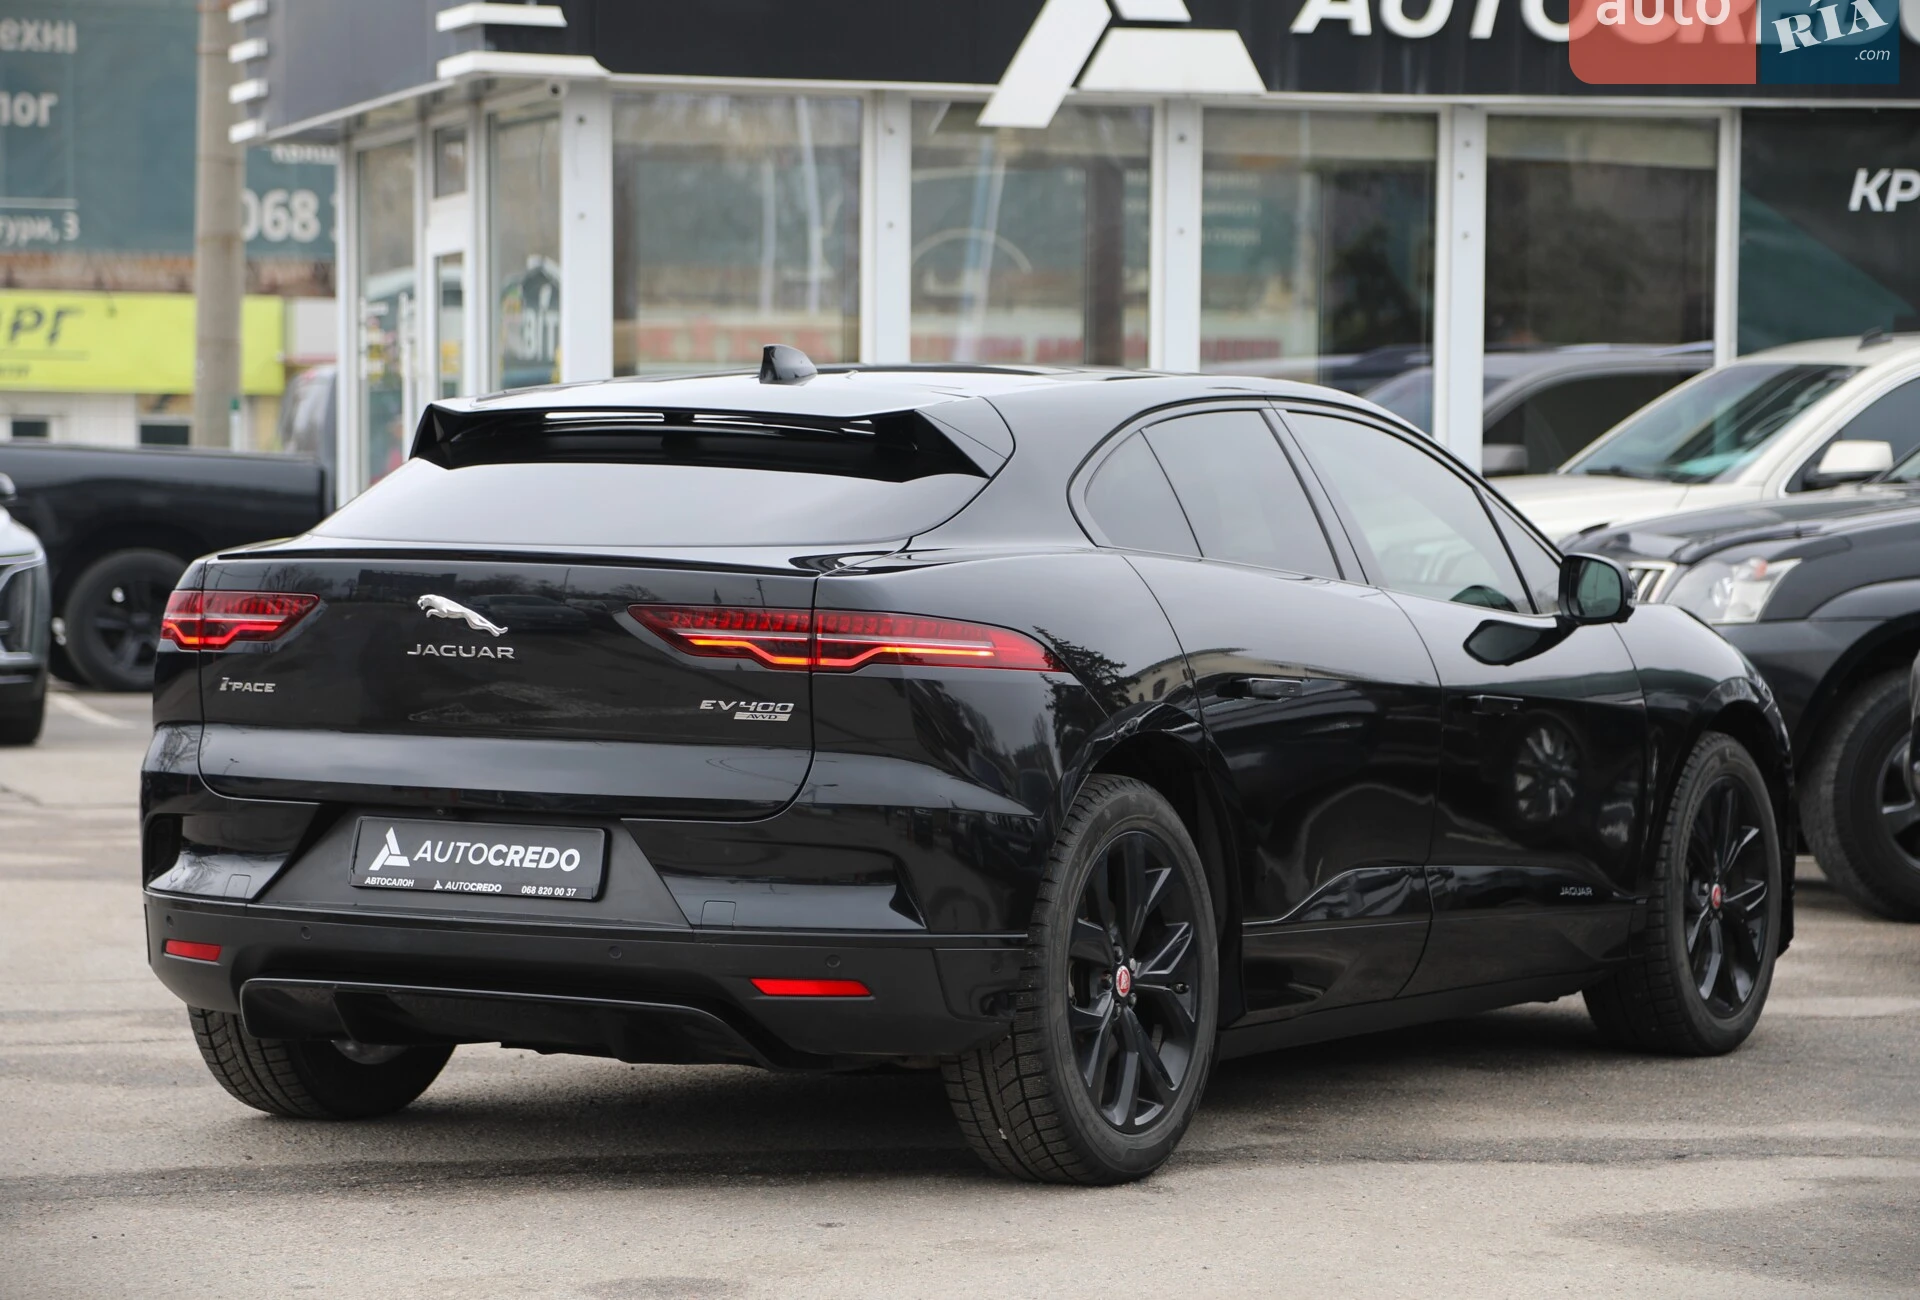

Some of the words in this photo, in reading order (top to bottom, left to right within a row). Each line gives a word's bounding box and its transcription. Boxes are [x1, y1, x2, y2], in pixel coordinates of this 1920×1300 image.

[407, 644, 515, 659] JAGUAR
[746, 713, 778, 721] AWD
[413, 840, 581, 872] AUTOCREDO
[364, 876, 415, 888] АВТОСАЛОН
[444, 881, 503, 893] AUTOCREDO
[521, 885, 537, 895] 068
[538, 886, 552, 896] 820
[554, 887, 565, 896] 00
[566, 888, 577, 897] 37
